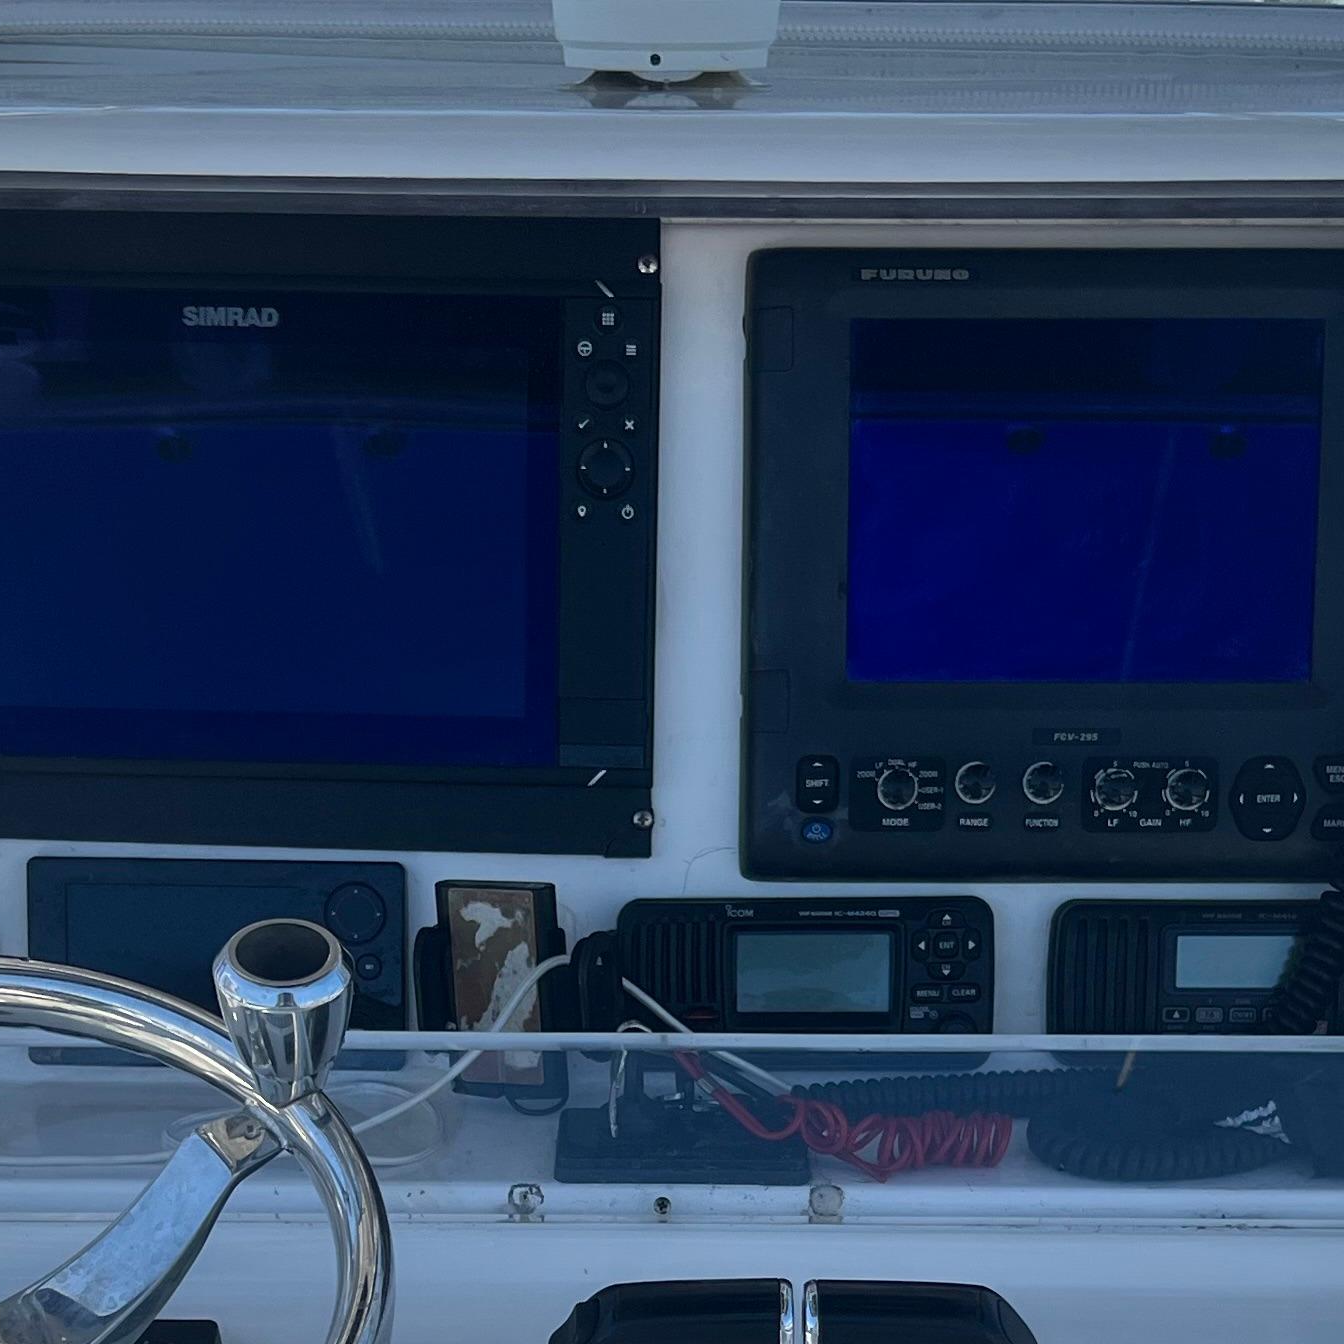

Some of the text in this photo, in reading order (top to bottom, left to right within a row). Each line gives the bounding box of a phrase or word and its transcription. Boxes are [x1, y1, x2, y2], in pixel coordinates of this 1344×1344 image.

[860, 268, 970, 281] FURUNO
[181, 305, 280, 328] SIMRAD
[805, 778, 831, 789] SHIFT
[1256, 793, 1281, 804] ENTER
[881, 817, 911, 827] MODE
[959, 817, 990, 828] RANGE
[1024, 817, 1060, 828] FUNCTION
[1139, 818, 1163, 827] GAIN
[938, 941, 955, 950] ENT
[916, 989, 941, 998] MENU
[951, 988, 977, 997] CLEAR
